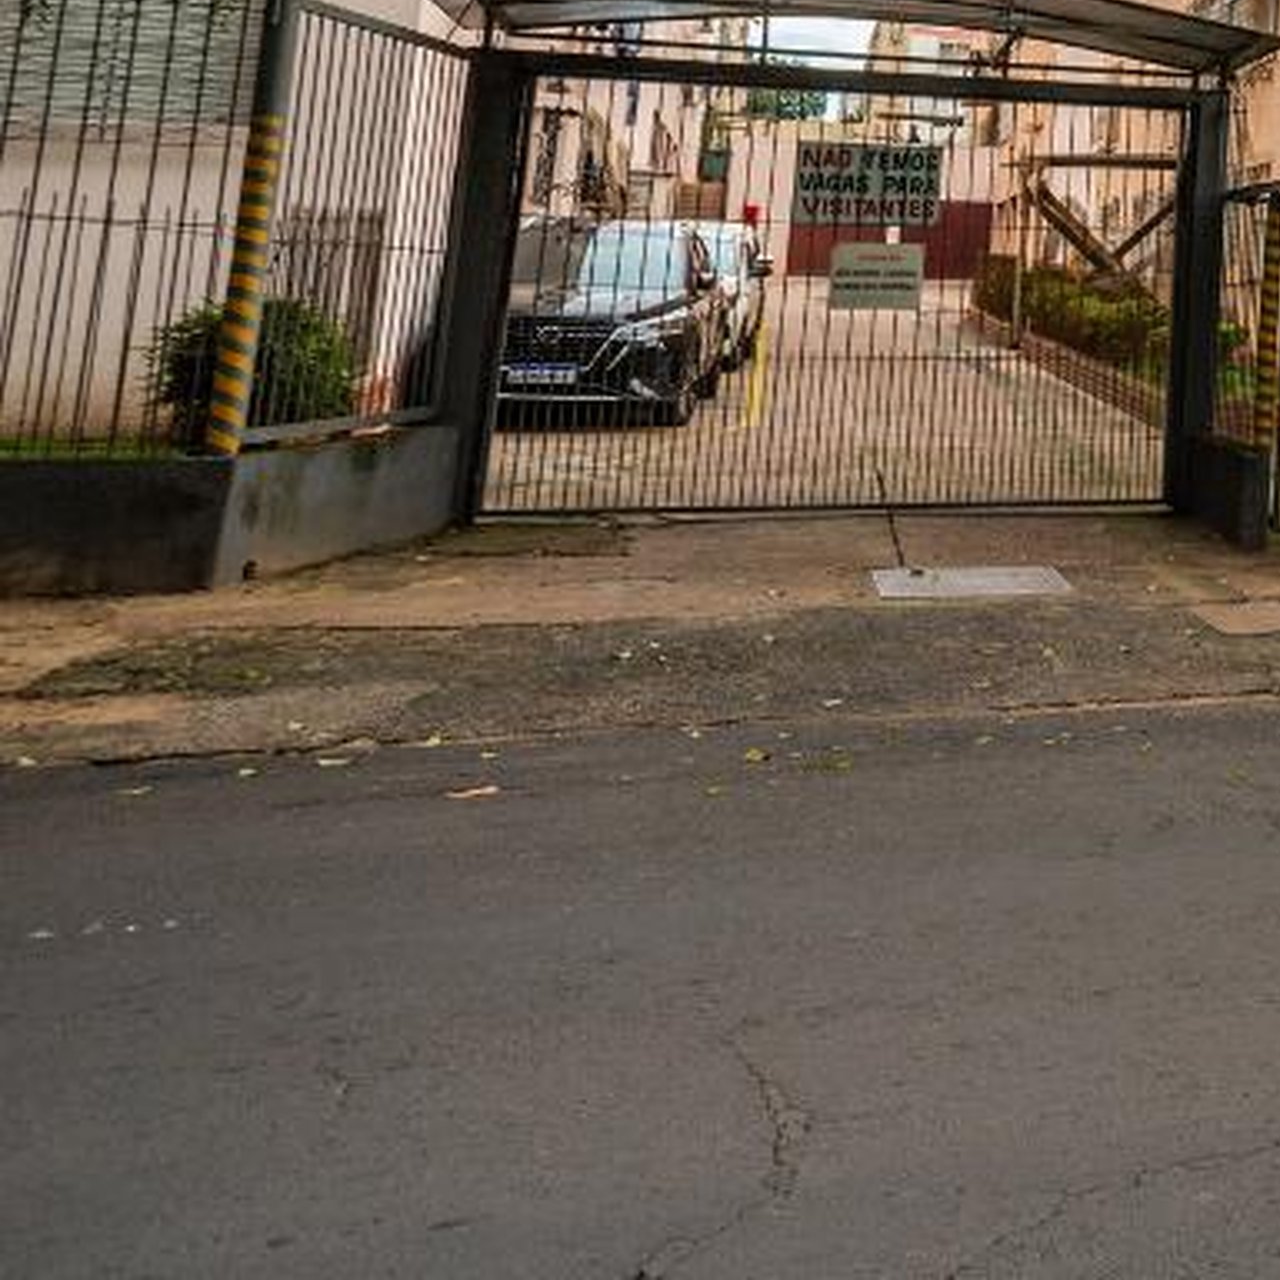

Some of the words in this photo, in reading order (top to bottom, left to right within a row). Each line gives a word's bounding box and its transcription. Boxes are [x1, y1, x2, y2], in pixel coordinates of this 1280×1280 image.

[860, 149, 939, 171] TEMOS
[799, 173, 869, 194] VAGAS
[882, 175, 937, 195] PARA
[801, 198, 936, 218] VISITANTES
